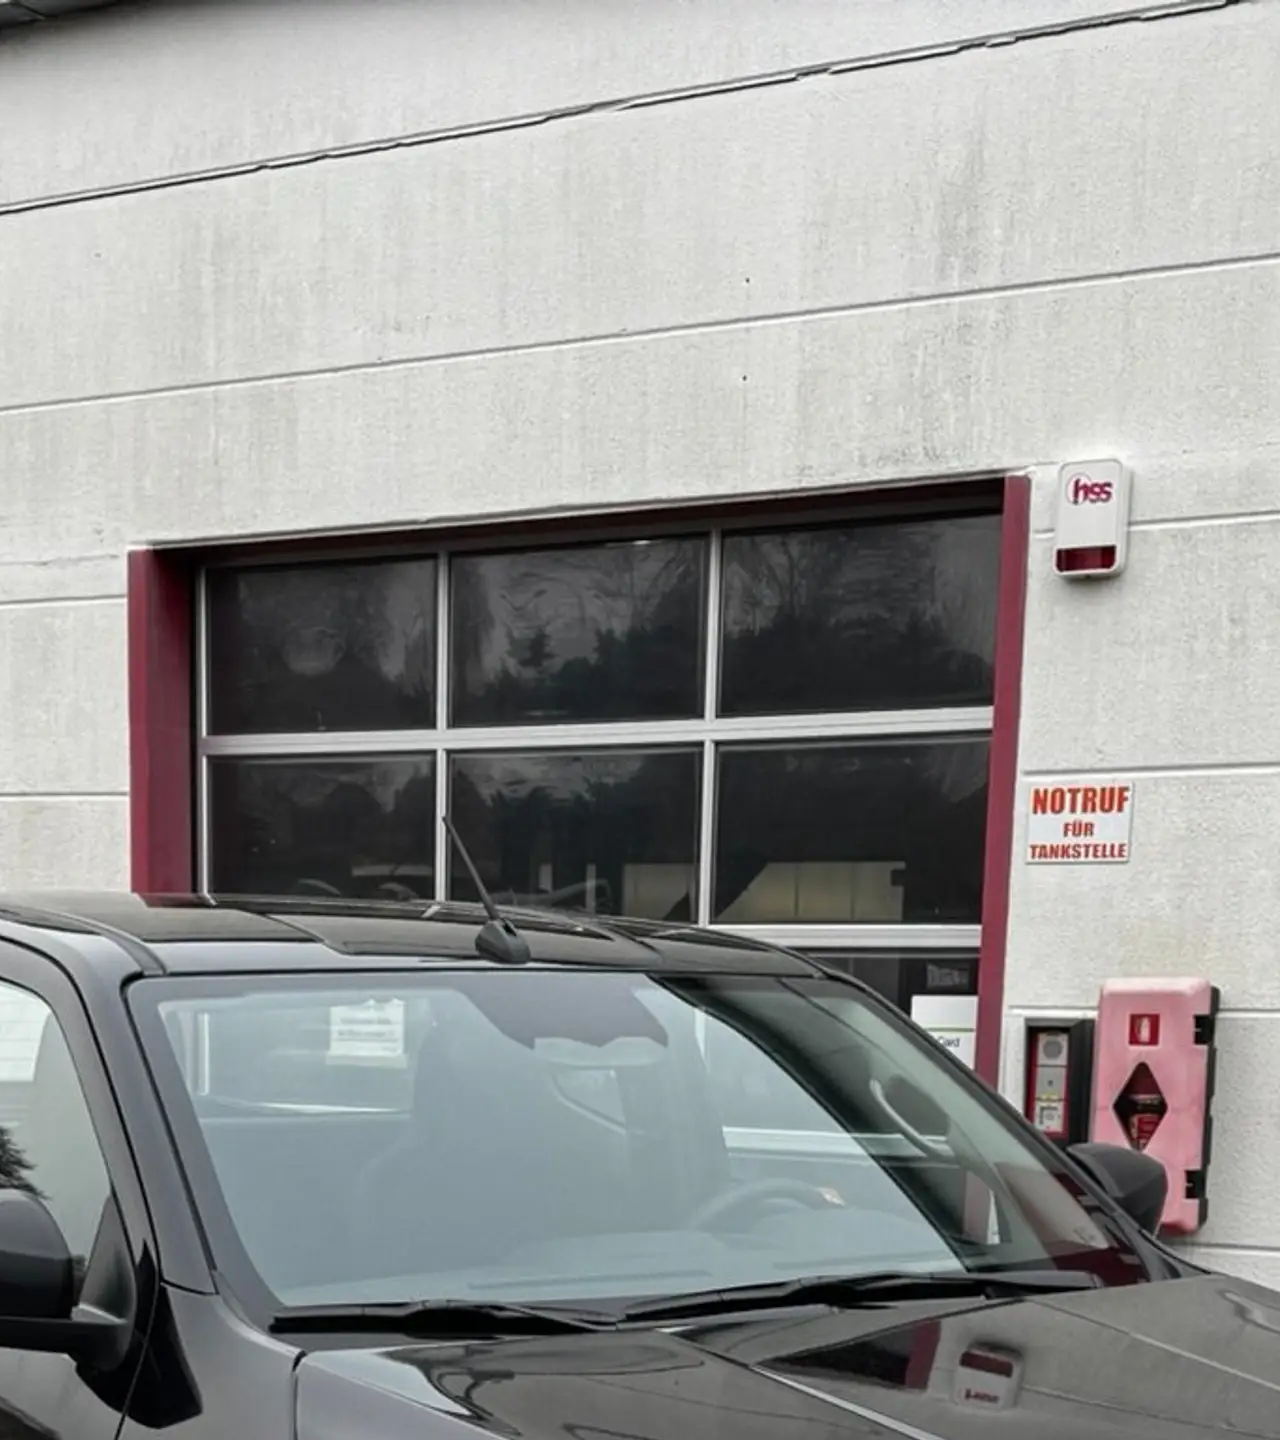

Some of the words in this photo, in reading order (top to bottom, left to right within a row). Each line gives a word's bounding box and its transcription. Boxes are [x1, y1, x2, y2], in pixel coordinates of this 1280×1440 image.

[1072, 478, 1113, 505] hss
[1032, 785, 1130, 815] NOTRUF
[1062, 818, 1095, 838] FÜR
[1029, 843, 1127, 860] TANKSTELLE
